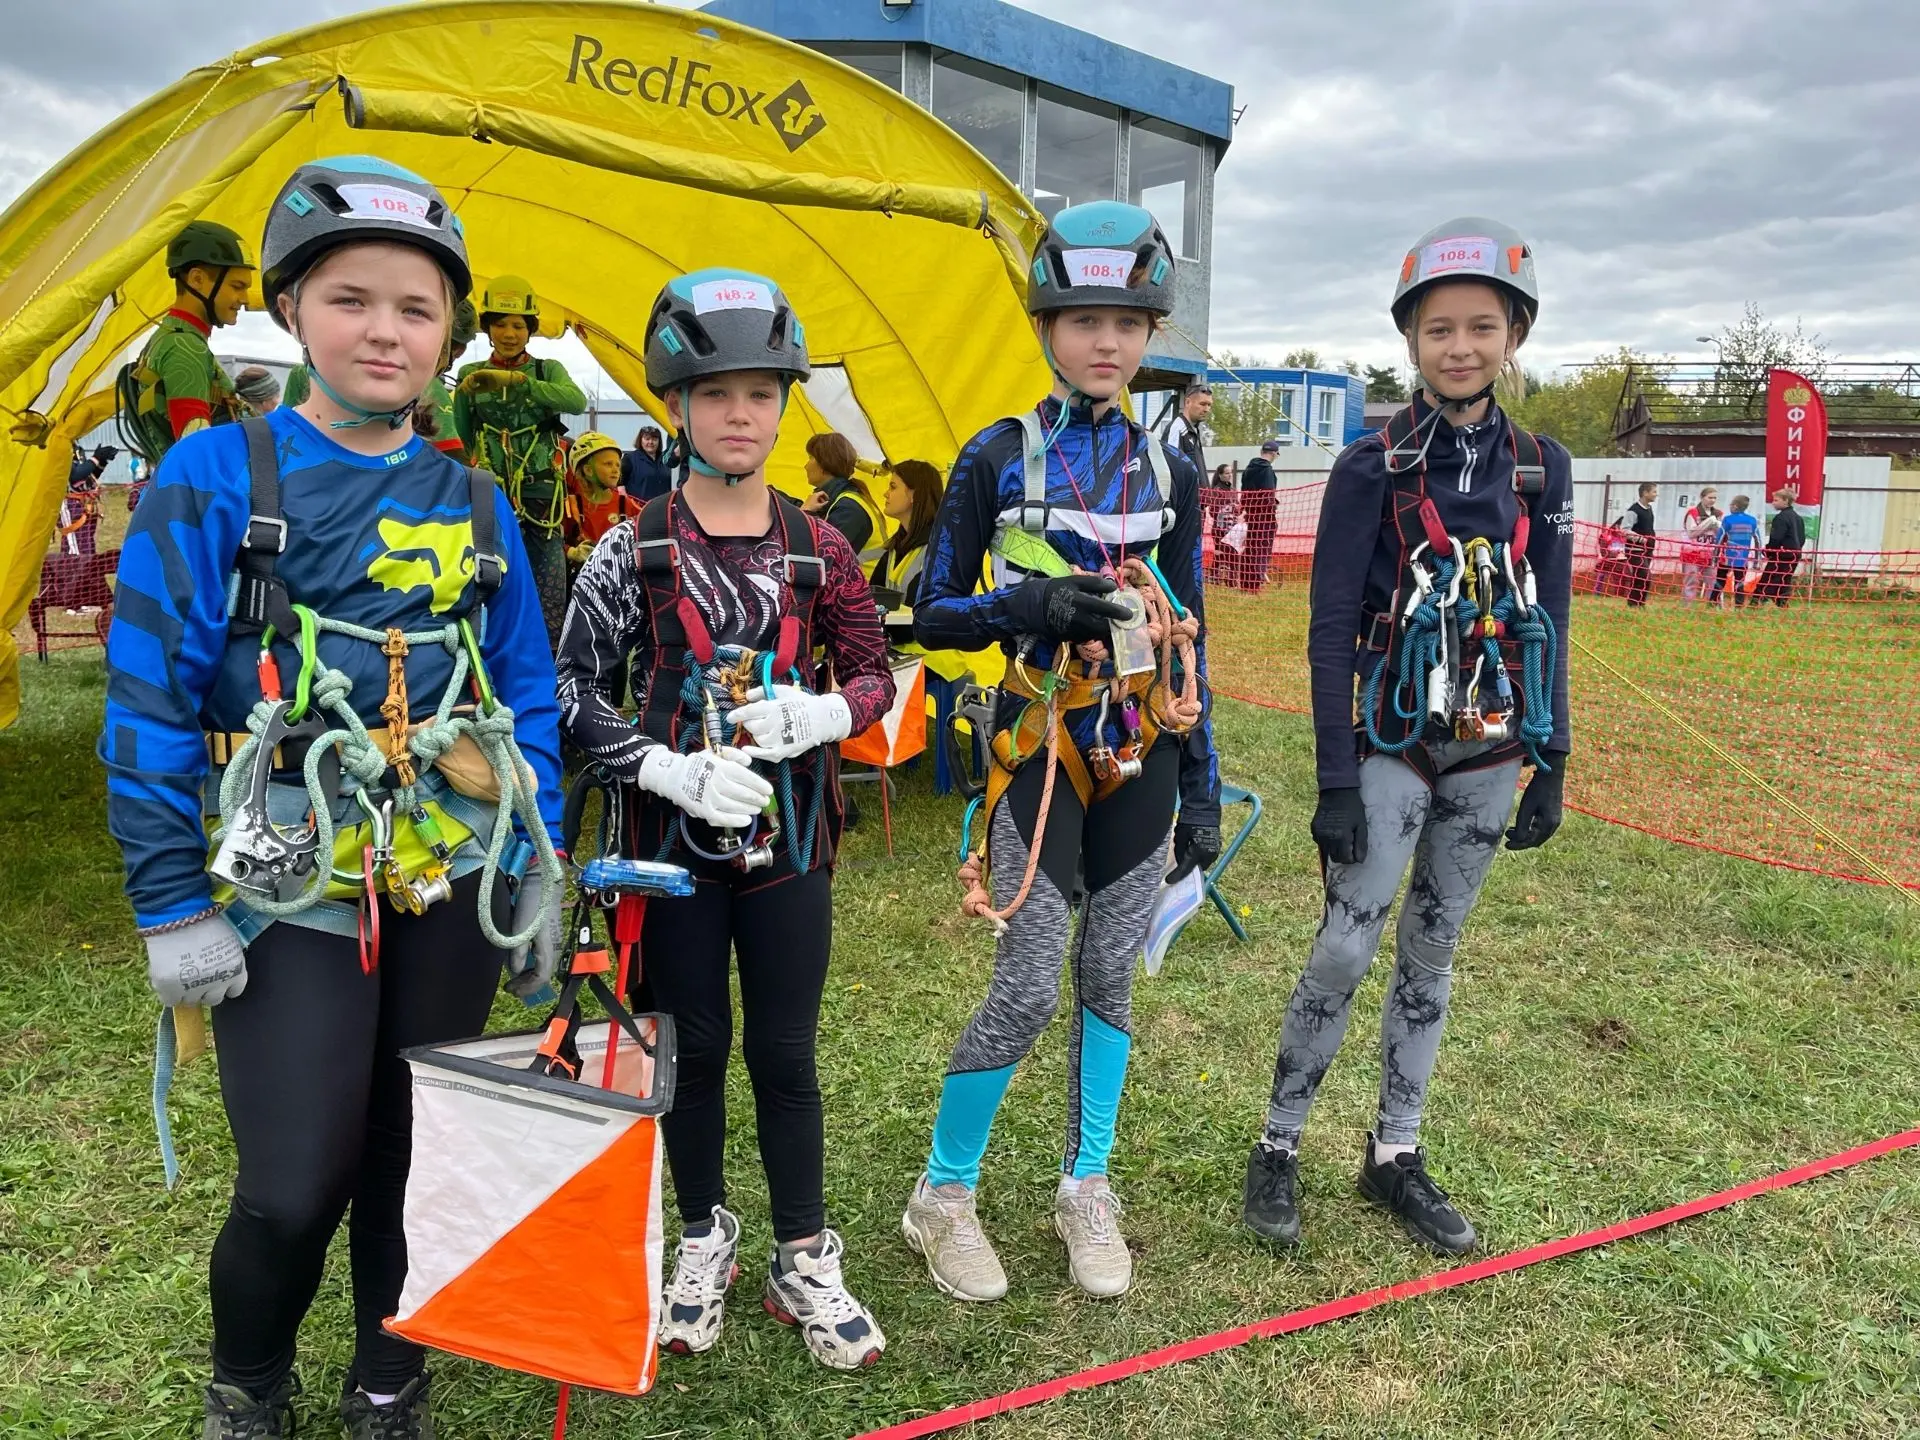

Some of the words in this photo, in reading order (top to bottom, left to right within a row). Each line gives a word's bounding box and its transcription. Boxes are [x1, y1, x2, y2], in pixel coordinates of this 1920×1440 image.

[565, 34, 766, 126] RedFox
[1439, 249, 1481, 262] 108.4
[1082, 264, 1124, 278] 108.1
[384, 450, 408, 466] 180
